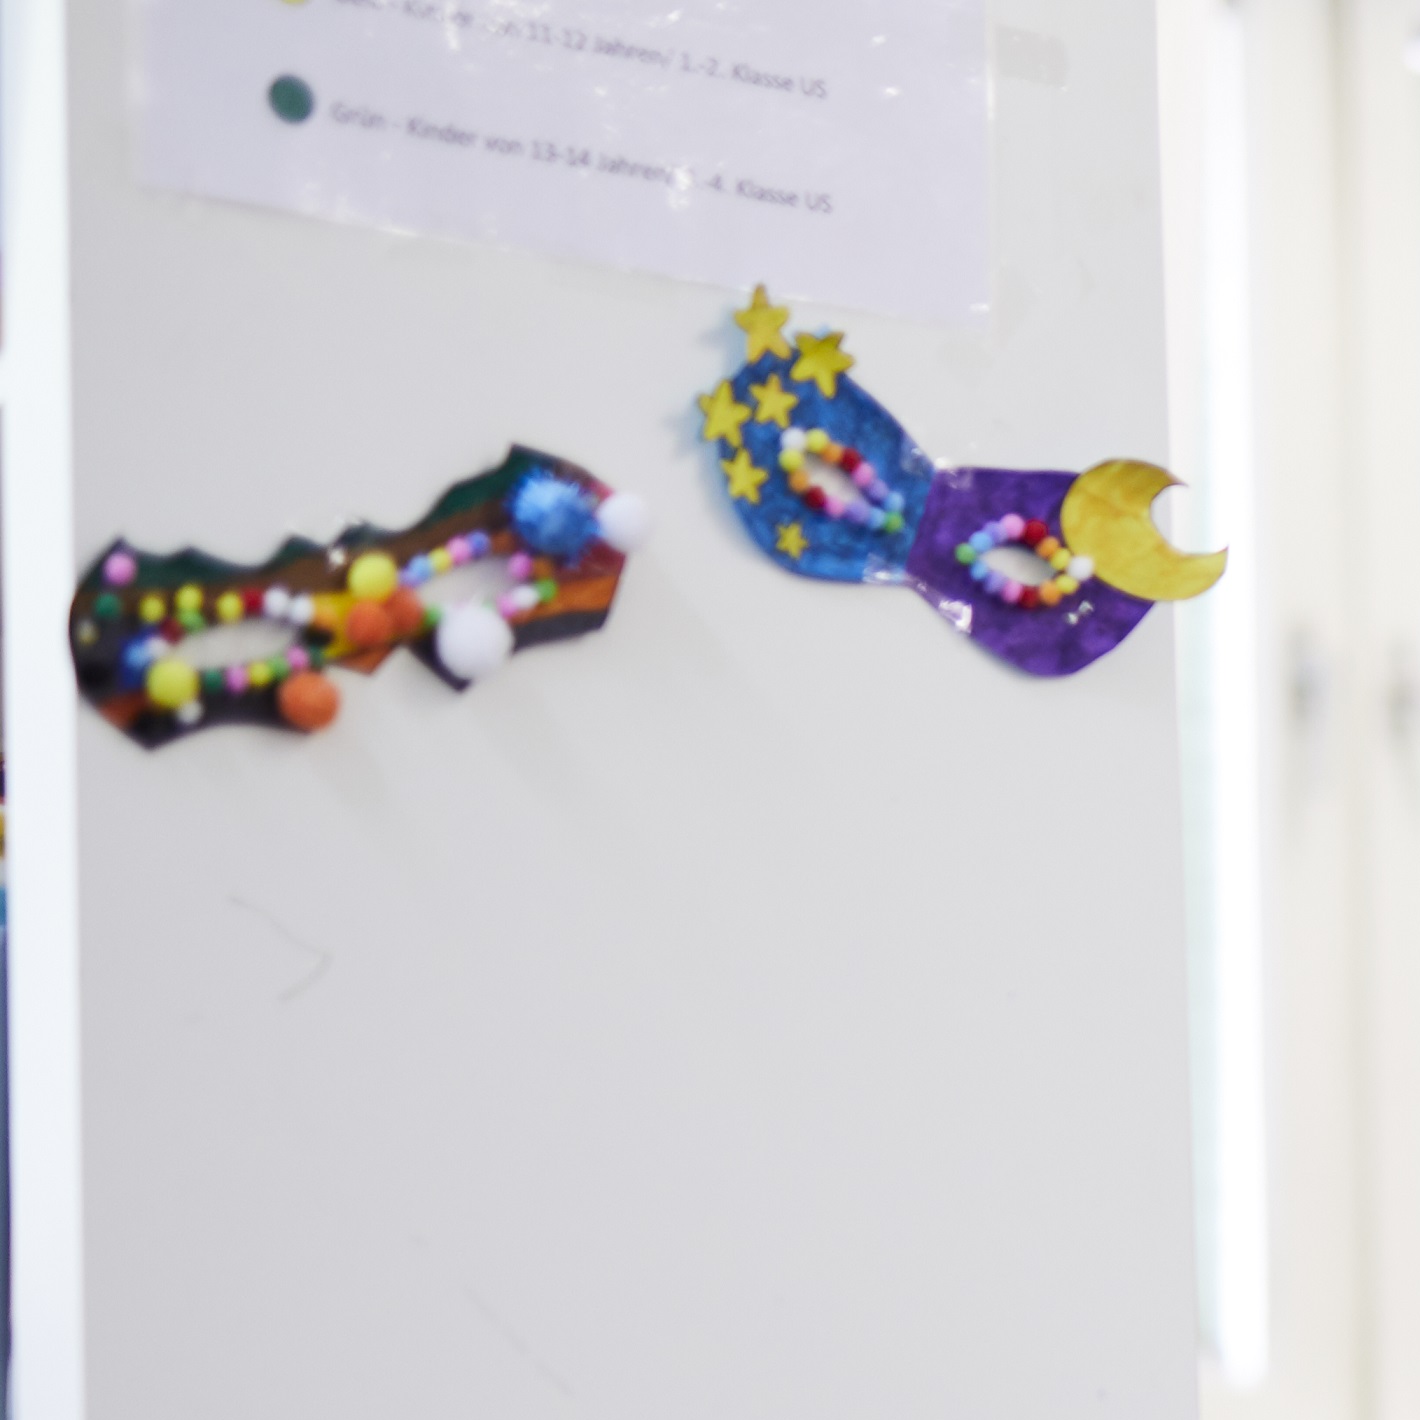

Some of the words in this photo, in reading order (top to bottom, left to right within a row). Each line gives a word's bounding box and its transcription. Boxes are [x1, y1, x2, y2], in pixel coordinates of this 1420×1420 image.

[731, 62, 795, 92] Klasse
[800, 75, 828, 100] US
[329, 100, 386, 130] Grün
[405, 115, 479, 147] Kinder
[484, 136, 524, 156] von
[531, 138, 592, 167] 13-14
[735, 177, 799, 208] Klasse
[803, 191, 833, 214] US
